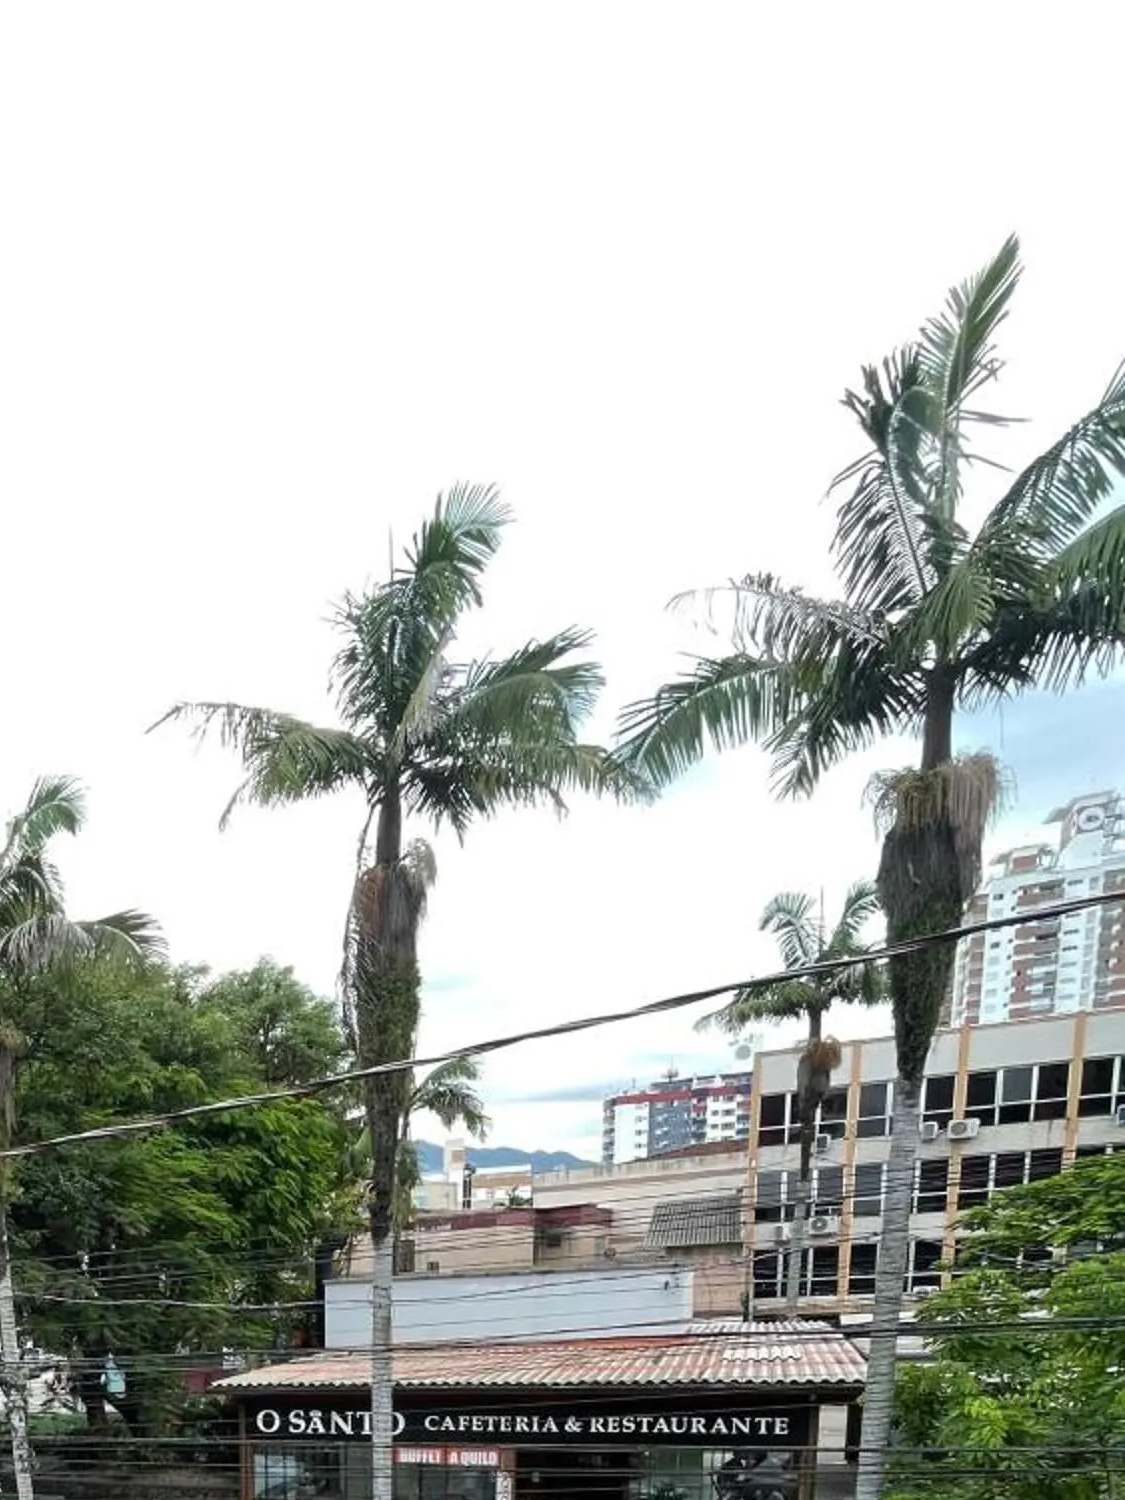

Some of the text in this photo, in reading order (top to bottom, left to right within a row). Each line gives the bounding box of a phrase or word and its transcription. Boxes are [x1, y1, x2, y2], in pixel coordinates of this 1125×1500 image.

[256, 1409, 280, 1433] O
[425, 1415, 559, 1433] CAFETERIA
[564, 1415, 583, 1433] &
[589, 1416, 790, 1435] RESTAURANTE
[399, 1448, 441, 1464] BUFFET
[460, 1450, 499, 1466] QUILO
